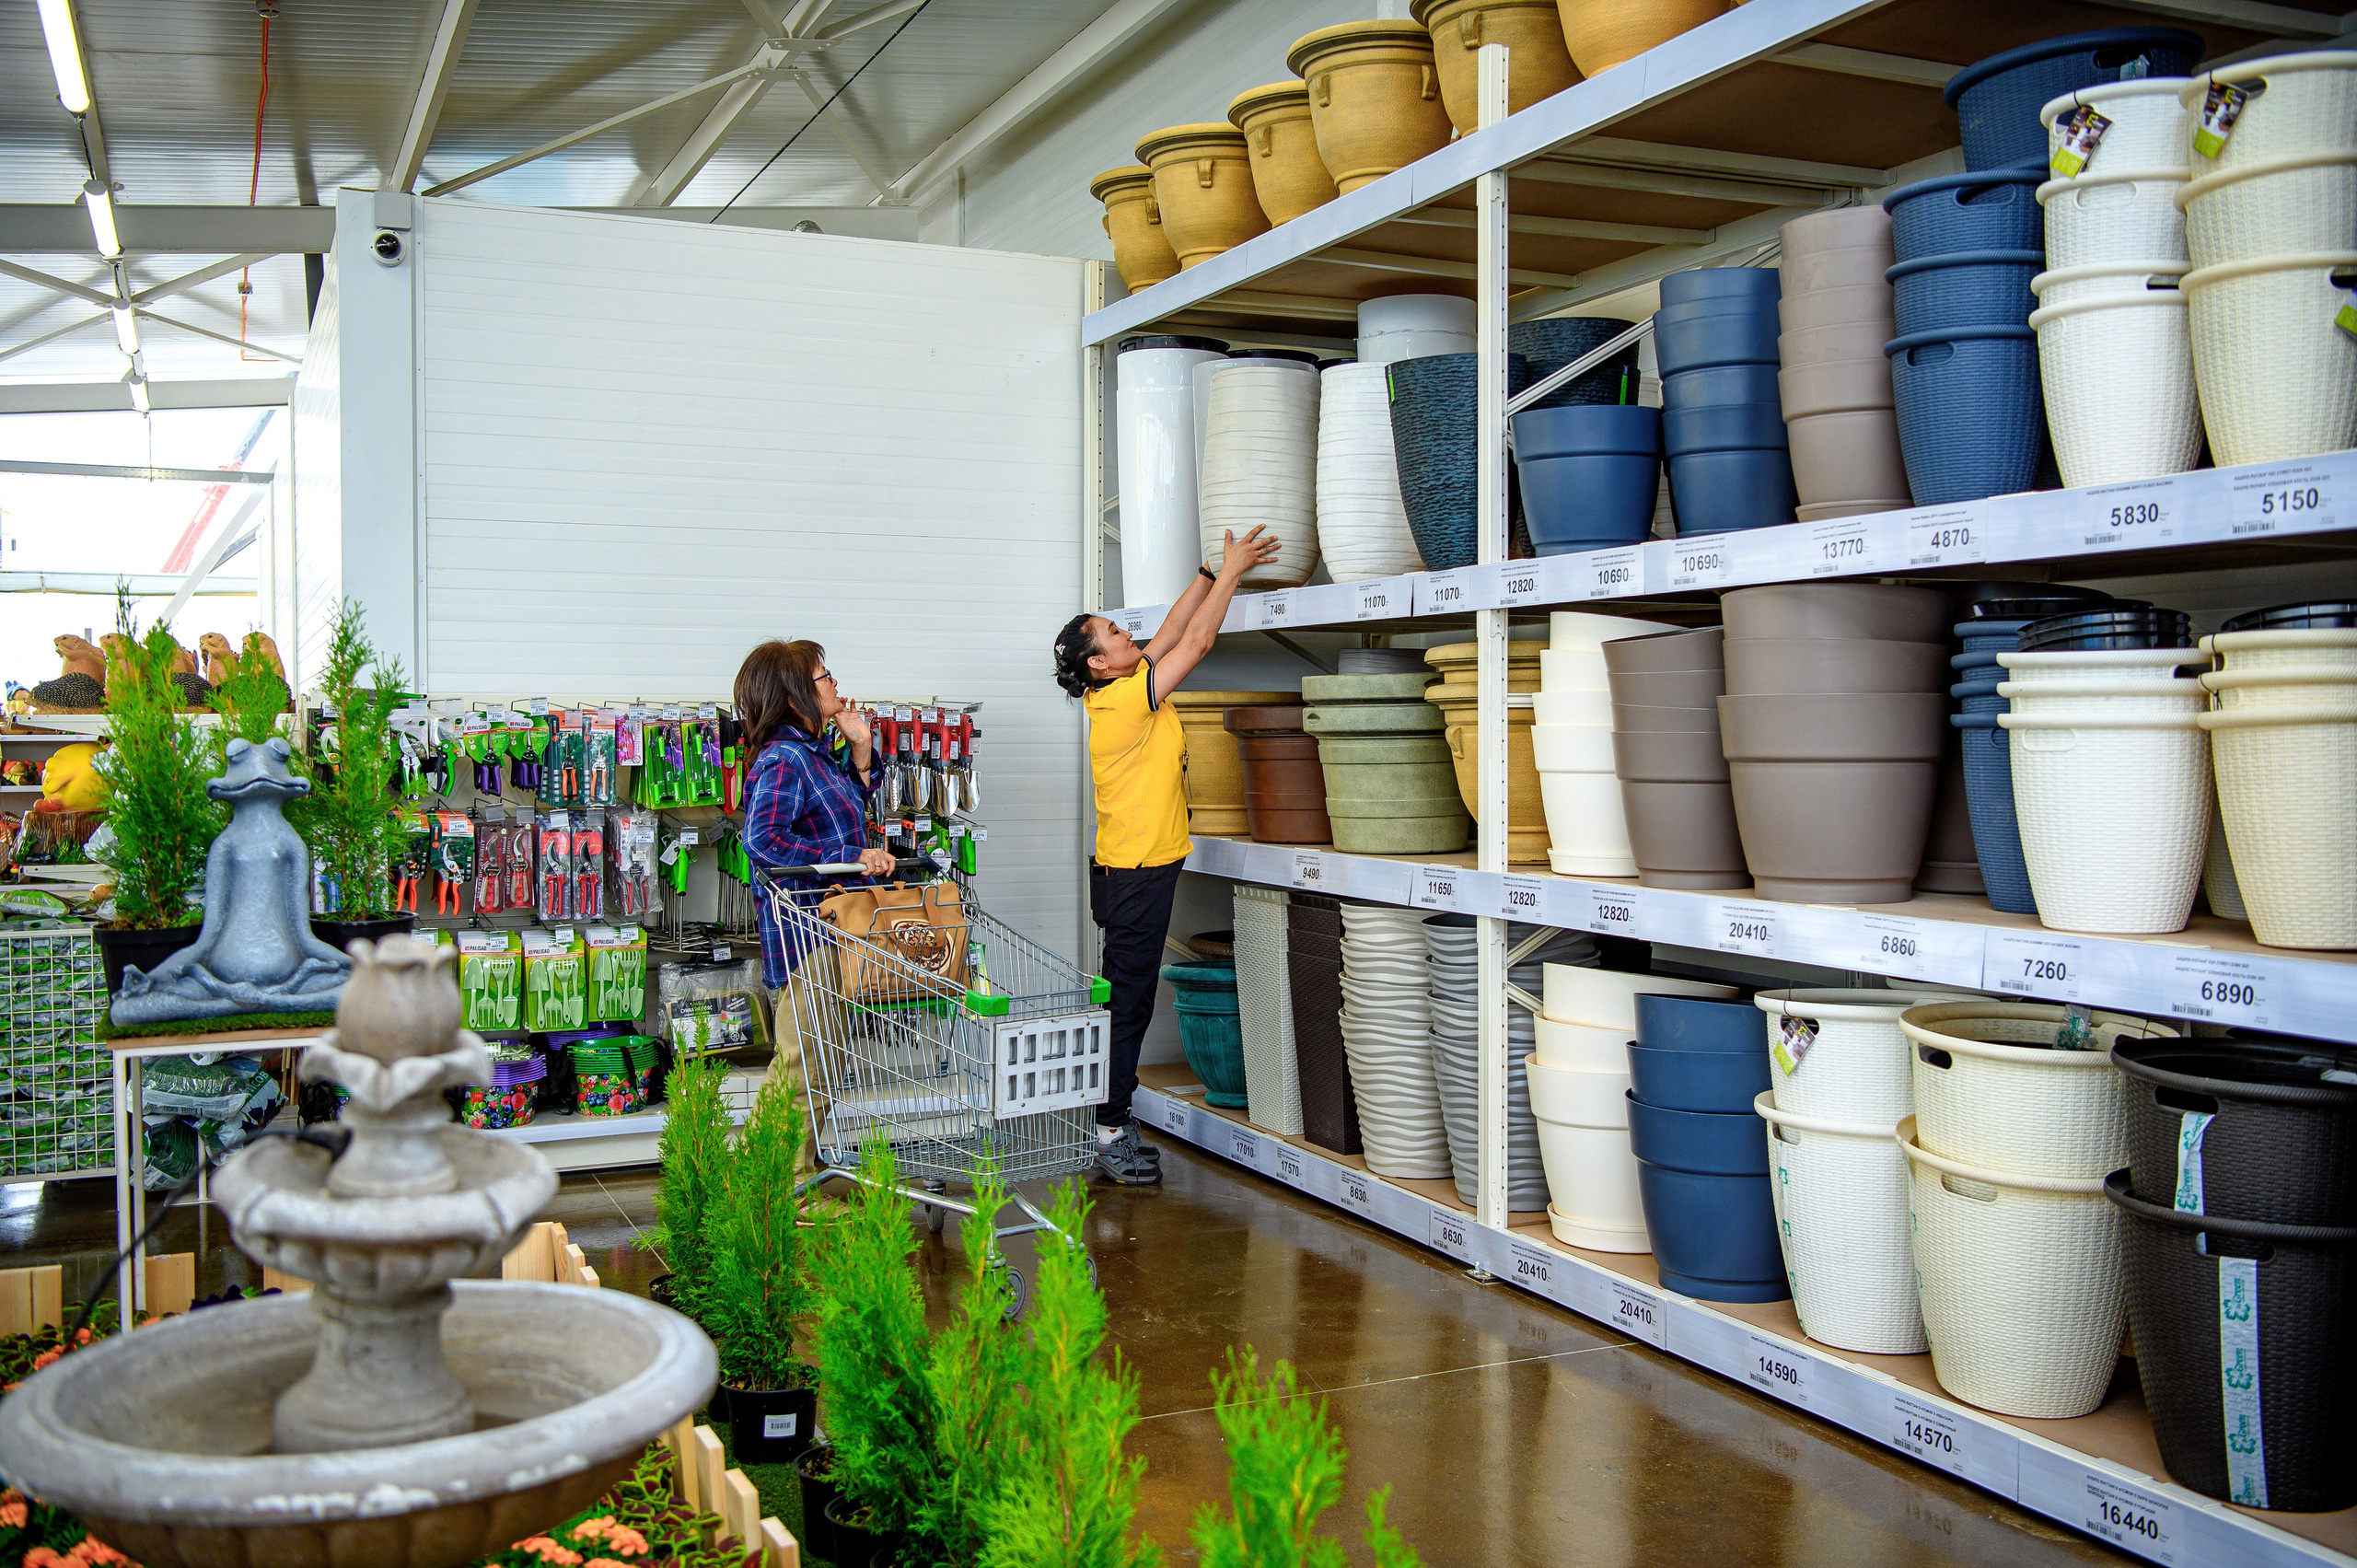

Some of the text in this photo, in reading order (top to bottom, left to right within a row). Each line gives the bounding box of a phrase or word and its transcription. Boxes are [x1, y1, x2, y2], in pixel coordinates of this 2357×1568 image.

[2262, 488, 2319, 514] 5150
[2110, 503, 2159, 527] 5830
[1931, 528, 1969, 549] 4870
[1823, 538, 1864, 560] 13770
[1682, 554, 1718, 573] 10690
[1507, 578, 1534, 594] 12820
[1597, 568, 1629, 586] 10690
[1364, 595, 1386, 609] 11070
[1434, 587, 1459, 601] 11070
[1270, 604, 1285, 616] 7490
[1303, 867, 1320, 880] 9490
[1428, 881, 1452, 896] 11650
[1508, 890, 1536, 907] 12820
[1598, 904, 1629, 922] 12820
[1729, 922, 1768, 941] 20410
[1881, 935, 1916, 957] 6860
[2024, 958, 2067, 981] 7260
[2201, 981, 2254, 1005] 6890
[1236, 1142, 1254, 1158] 17010
[1281, 1160, 1300, 1178] 17570
[1350, 1186, 1366, 1203] 8630
[1443, 1226, 1462, 1247] 8630
[1517, 1260, 1547, 1282] 20410
[1620, 1300, 1652, 1324] 20410
[1759, 1355, 1797, 1385] 14590
[1904, 1420, 1952, 1453] 14570
[2100, 1501, 2158, 1539] 16440
